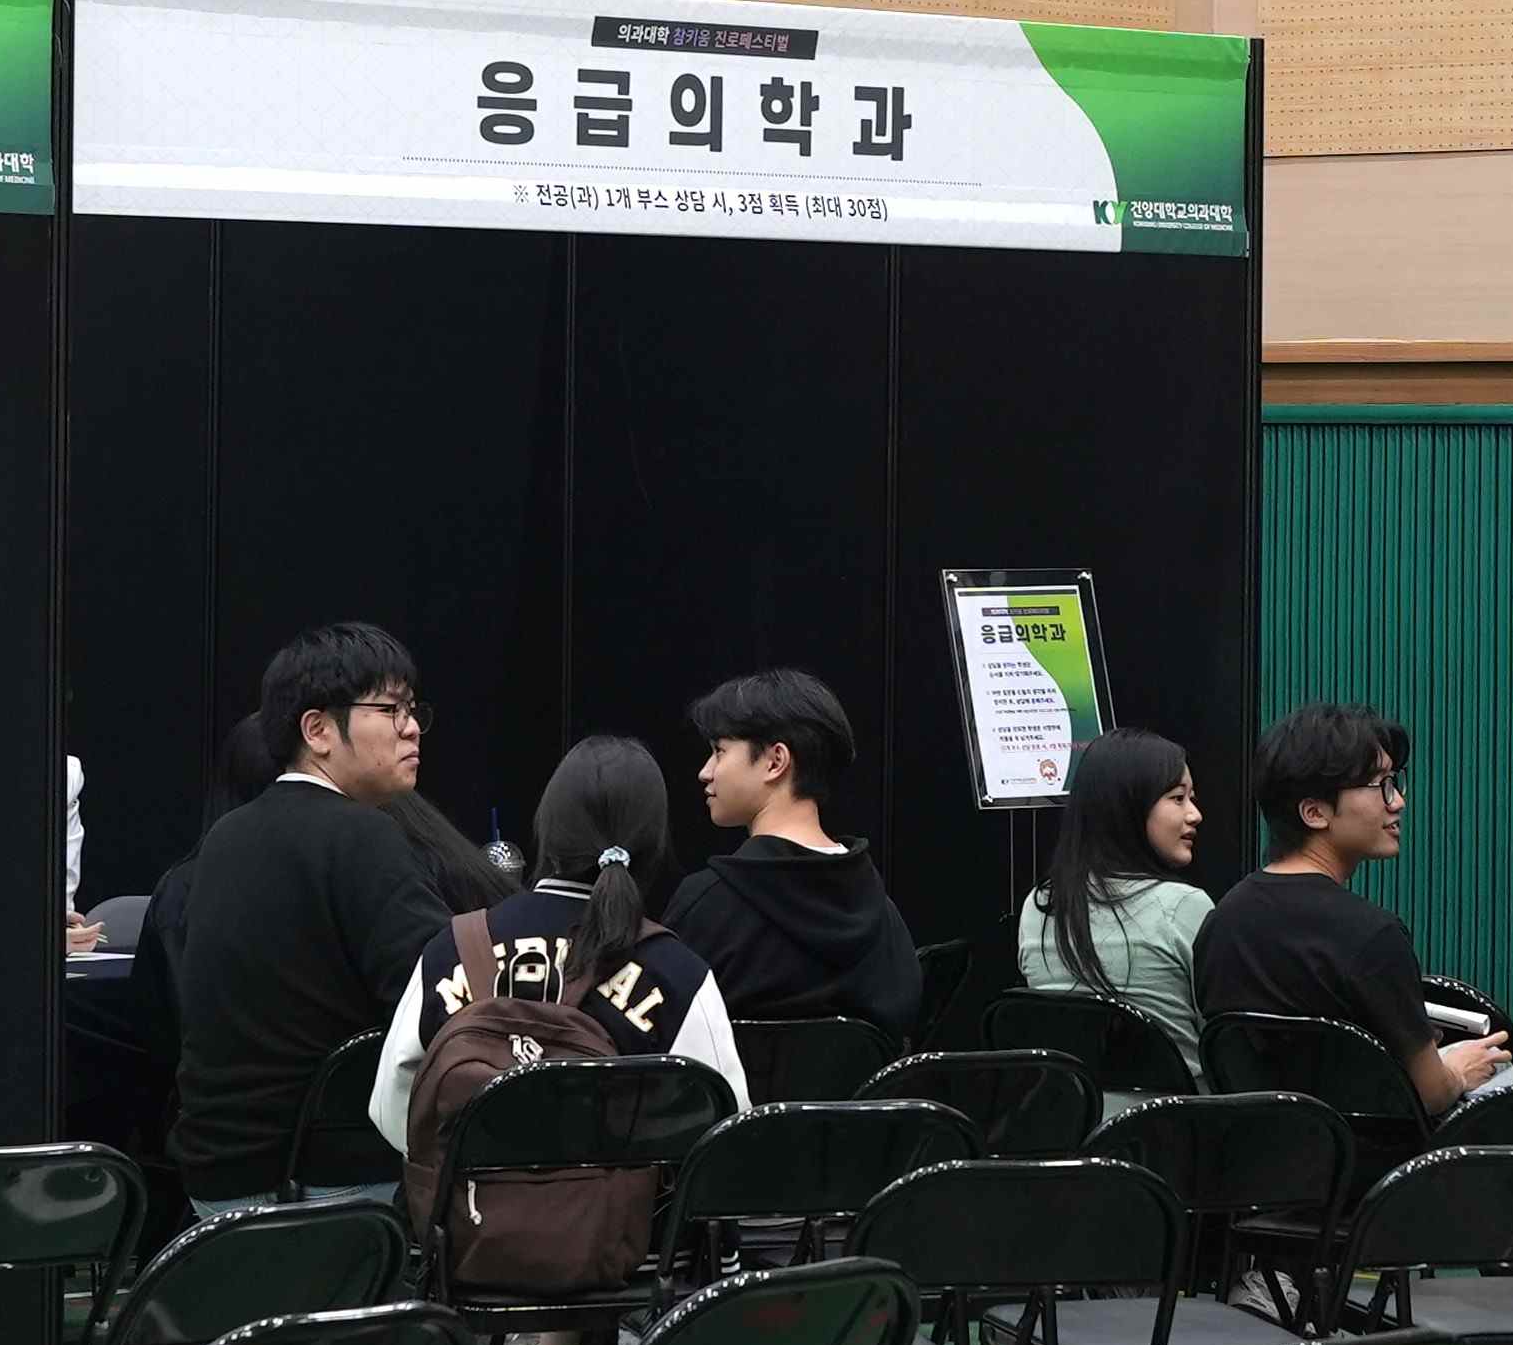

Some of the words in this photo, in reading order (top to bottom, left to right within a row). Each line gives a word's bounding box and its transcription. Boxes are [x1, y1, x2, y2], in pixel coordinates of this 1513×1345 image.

[618, 24, 670, 45] 의과대학
[477, 61, 911, 161] 응급의학과
[537, 185, 598, 210] 전공(과)
[606, 188, 631, 209] 1개
[638, 189, 668, 209] 부스
[675, 191, 704, 212] 상담
[713, 192, 733, 215] 시,
[738, 194, 763, 214] 3점
[769, 195, 798, 215] 획득
[806, 196, 842, 218] (최대
[848, 199, 887, 221] 30점)
[1130, 201, 1232, 222] 건양대학교의과대학
[981, 623, 1066, 644] 응급의학과
